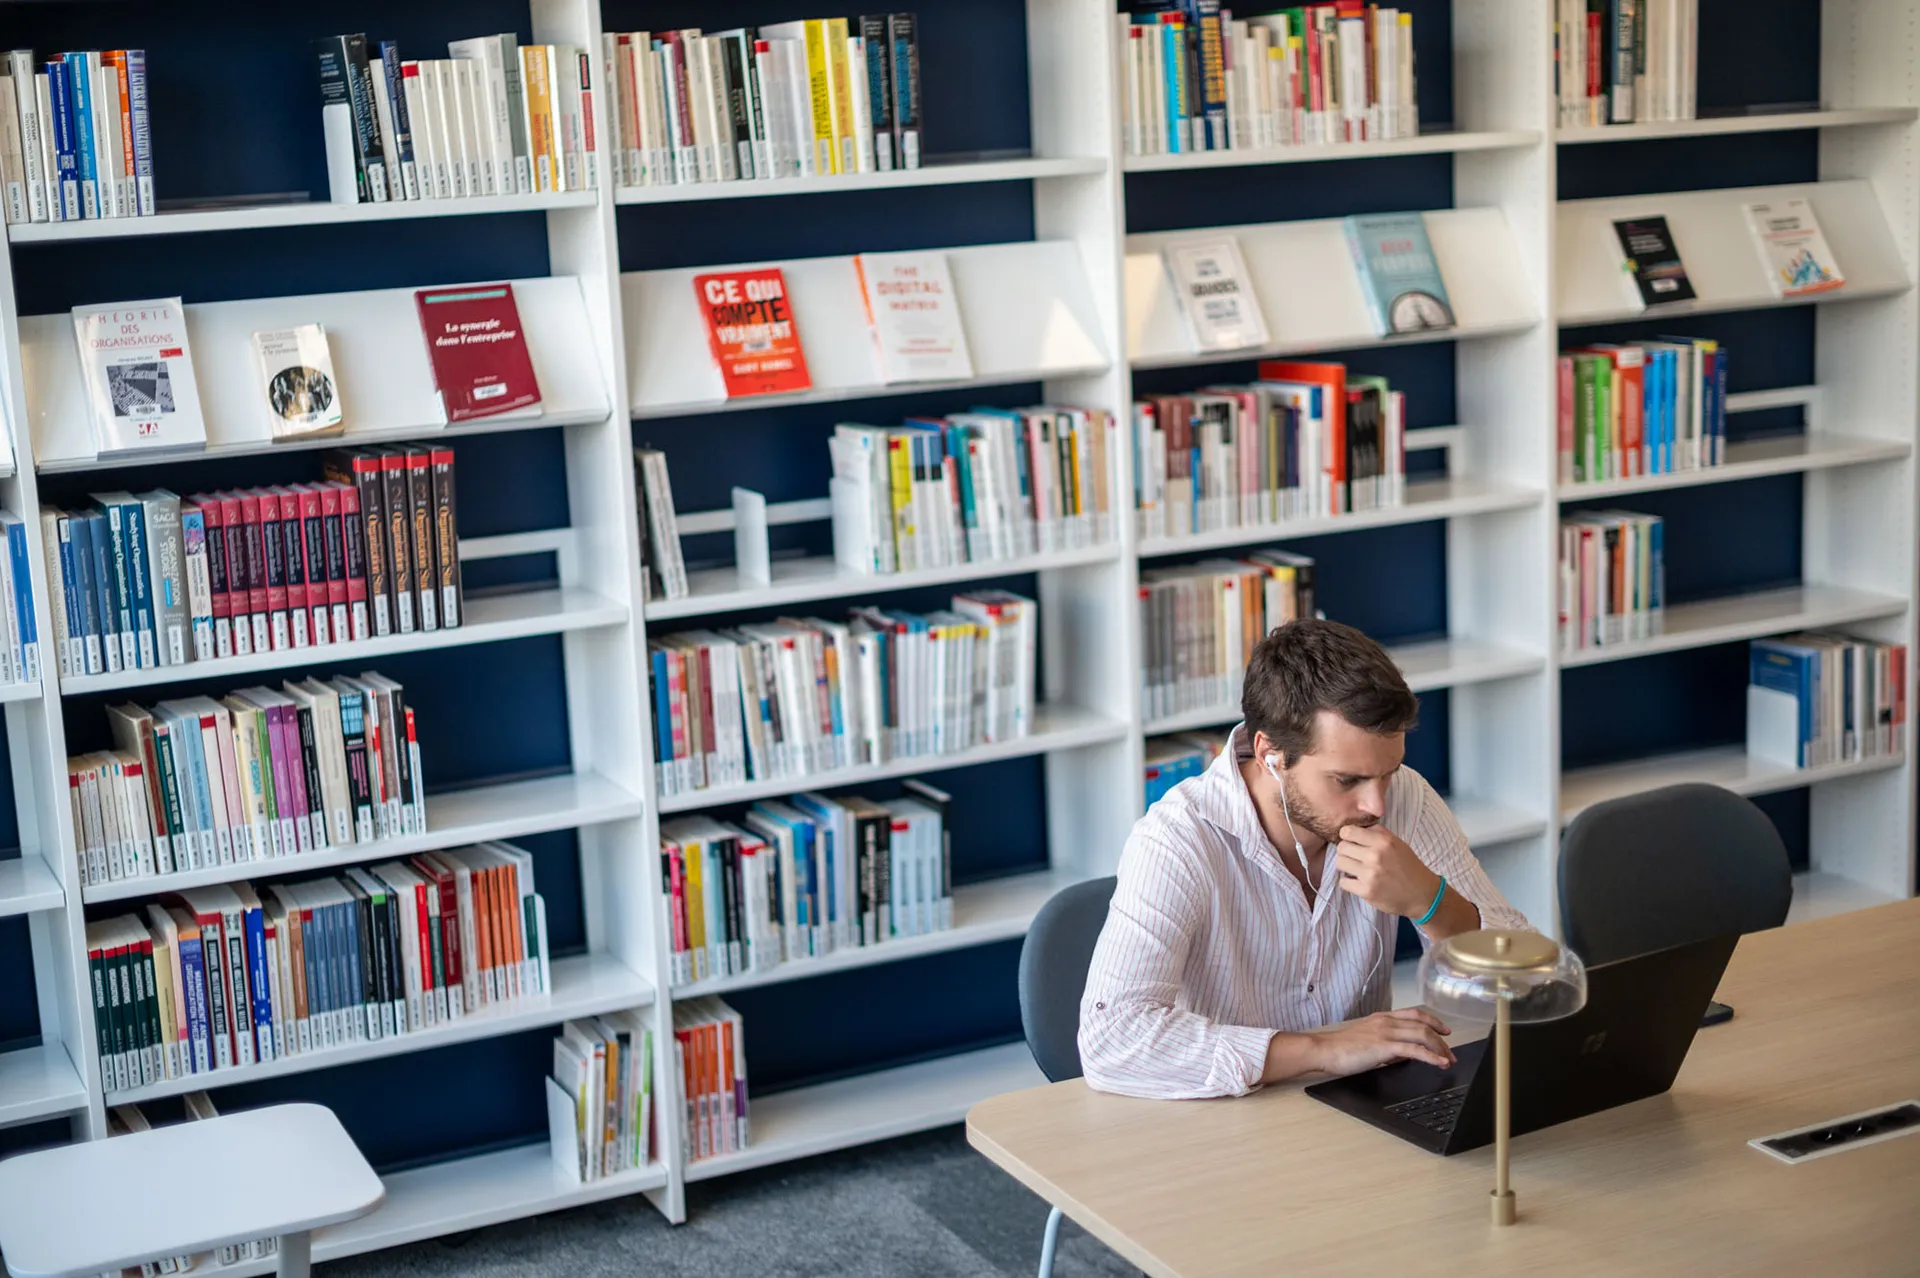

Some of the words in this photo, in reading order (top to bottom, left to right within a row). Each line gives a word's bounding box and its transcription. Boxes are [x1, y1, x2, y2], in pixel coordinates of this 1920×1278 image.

[130, 72, 146, 100] LEVERS
[134, 100, 146, 110] OF
[134, 110, 150, 160] ORGANIZATION
[893, 265, 917, 277] THE
[704, 279, 743, 305] CE
[744, 279, 784, 302] QUI
[876, 280, 944, 296] DIGITAL
[86, 309, 169, 325] THÉORIE
[712, 297, 790, 325] COMPTE
[121, 324, 140, 334] DES
[459, 318, 501, 333] synergie
[90, 332, 174, 348] ORGANISATIONS
[435, 336, 460, 347] dans
[307, 500, 315, 515] 6
[327, 498, 336, 514] 7
[392, 485, 402, 503] 2
[129, 512, 141, 546] Studying
[229, 512, 236, 524] 2
[367, 514, 381, 575] Organization
[392, 511, 405, 572] Organization
[415, 508, 427, 569] Organization
[439, 505, 450, 566] Organization
[132, 547, 144, 599] Organization
[160, 540, 170, 578] STUDIES
[167, 535, 180, 606] ORGANIZATION
[115, 552, 127, 608] Organizations
[250, 759, 263, 795] DESIGN
[185, 963, 197, 1019] ORGANIZATION
[195, 970, 207, 1023] MANAGEMENT
[190, 1020, 199, 1040] THEO
